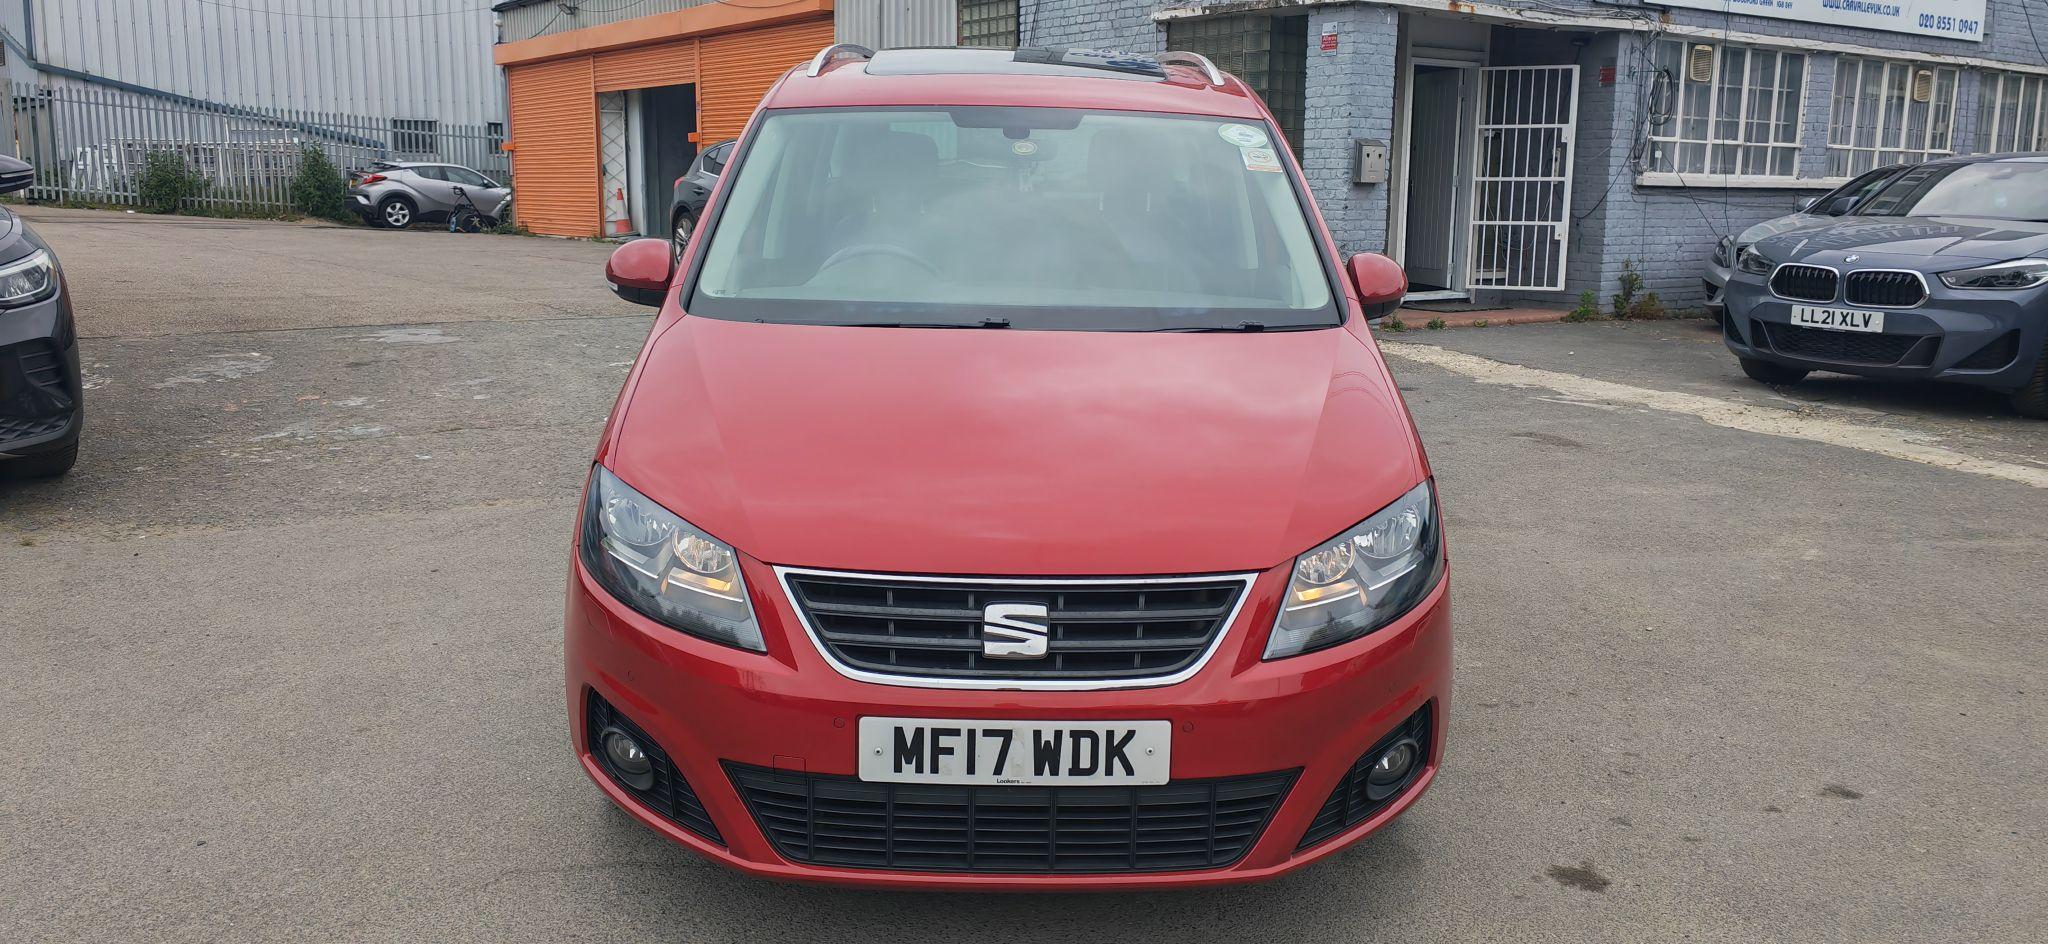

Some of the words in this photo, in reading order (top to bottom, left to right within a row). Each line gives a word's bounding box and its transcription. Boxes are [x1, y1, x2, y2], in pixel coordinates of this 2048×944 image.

[1918, 13, 1935, 29] 020
[1936, 15, 1956, 32] 8551
[1958, 18, 1979, 35] 0947
[1800, 308, 1836, 325] LL21
[1839, 311, 1872, 328] XLV
[893, 726, 1013, 776] MF17
[1032, 729, 1137, 777] WDK
